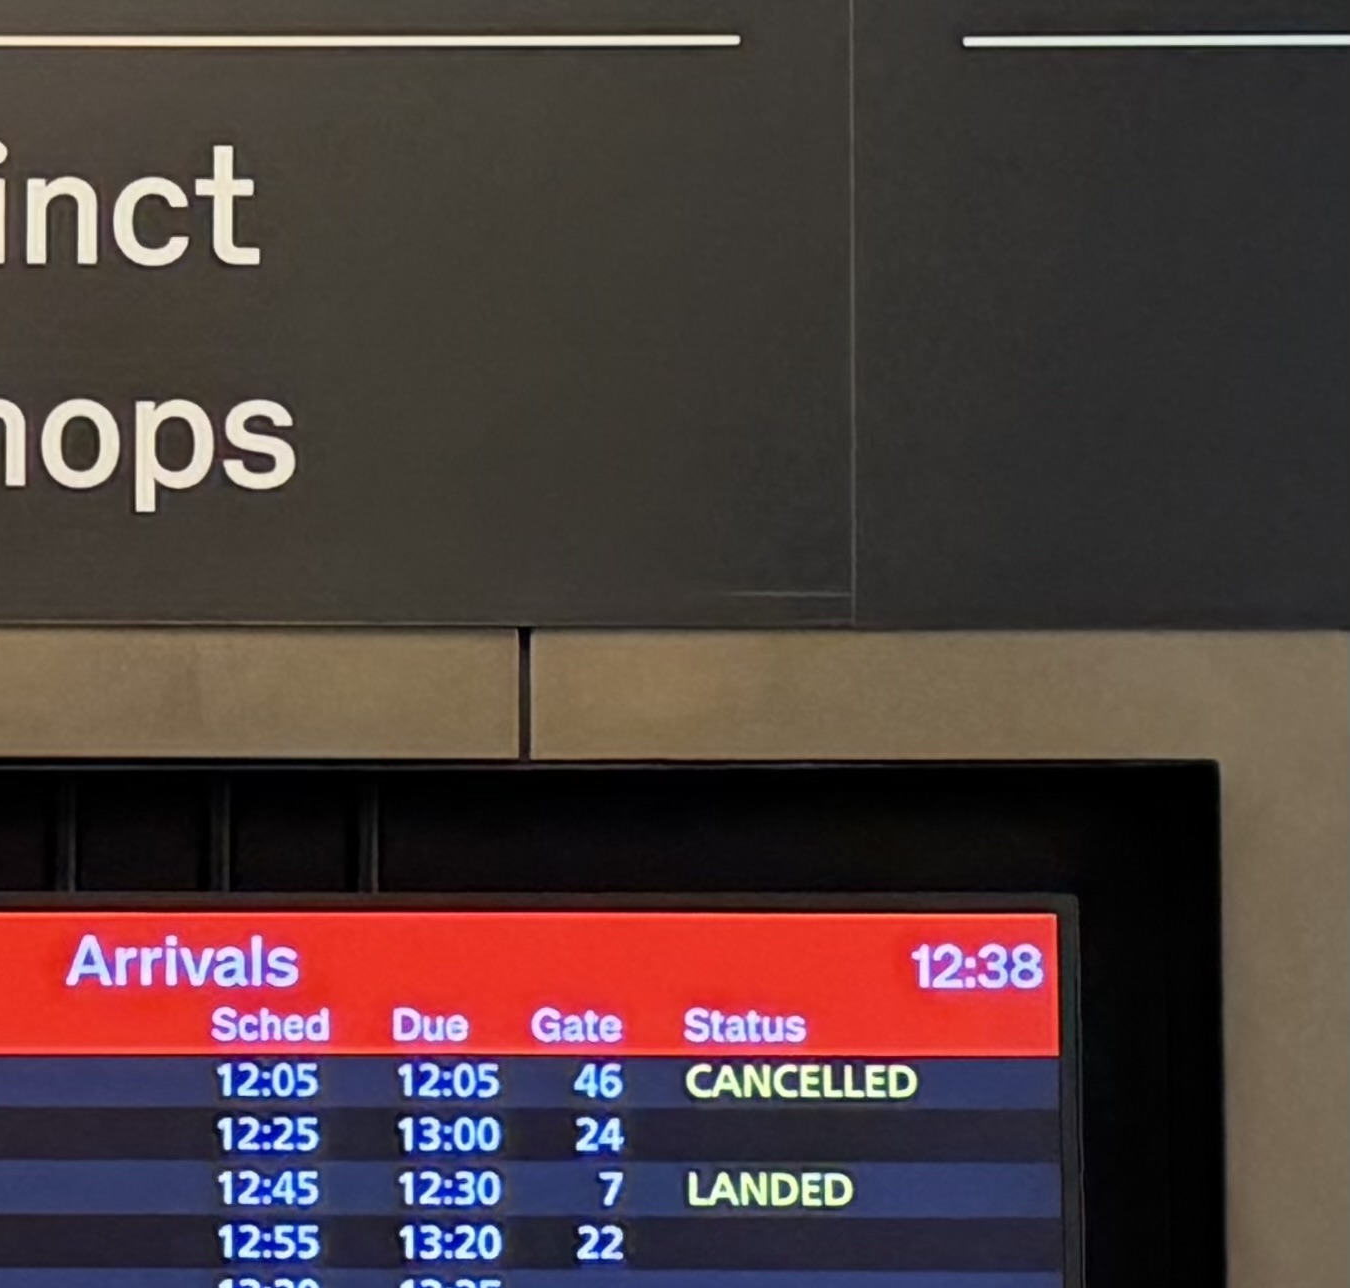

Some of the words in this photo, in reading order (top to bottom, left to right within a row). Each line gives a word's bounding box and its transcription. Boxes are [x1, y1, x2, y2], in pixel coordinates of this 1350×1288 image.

[65, 933, 300, 988] Arrivals
[910, 942, 1045, 990] 12:38
[211, 1005, 331, 1043] Sched
[392, 1006, 470, 1043] Due
[530, 1006, 623, 1044] Gate
[683, 1006, 808, 1044] Status
[216, 1061, 320, 1098] 12:05
[397, 1061, 501, 1099] 12:05
[573, 1062, 624, 1099] 46
[684, 1062, 919, 1100] CANCELLED
[216, 1115, 320, 1152] 12:25
[397, 1115, 502, 1153] 13:00
[574, 1115, 626, 1153] 24
[217, 1169, 320, 1206] 12:45
[397, 1170, 502, 1207] 12:30
[598, 1170, 624, 1207] 7
[687, 1170, 855, 1208] LANDED
[217, 1223, 321, 1261] 12:55
[398, 1223, 503, 1261] 13:20
[575, 1224, 625, 1261] 22
